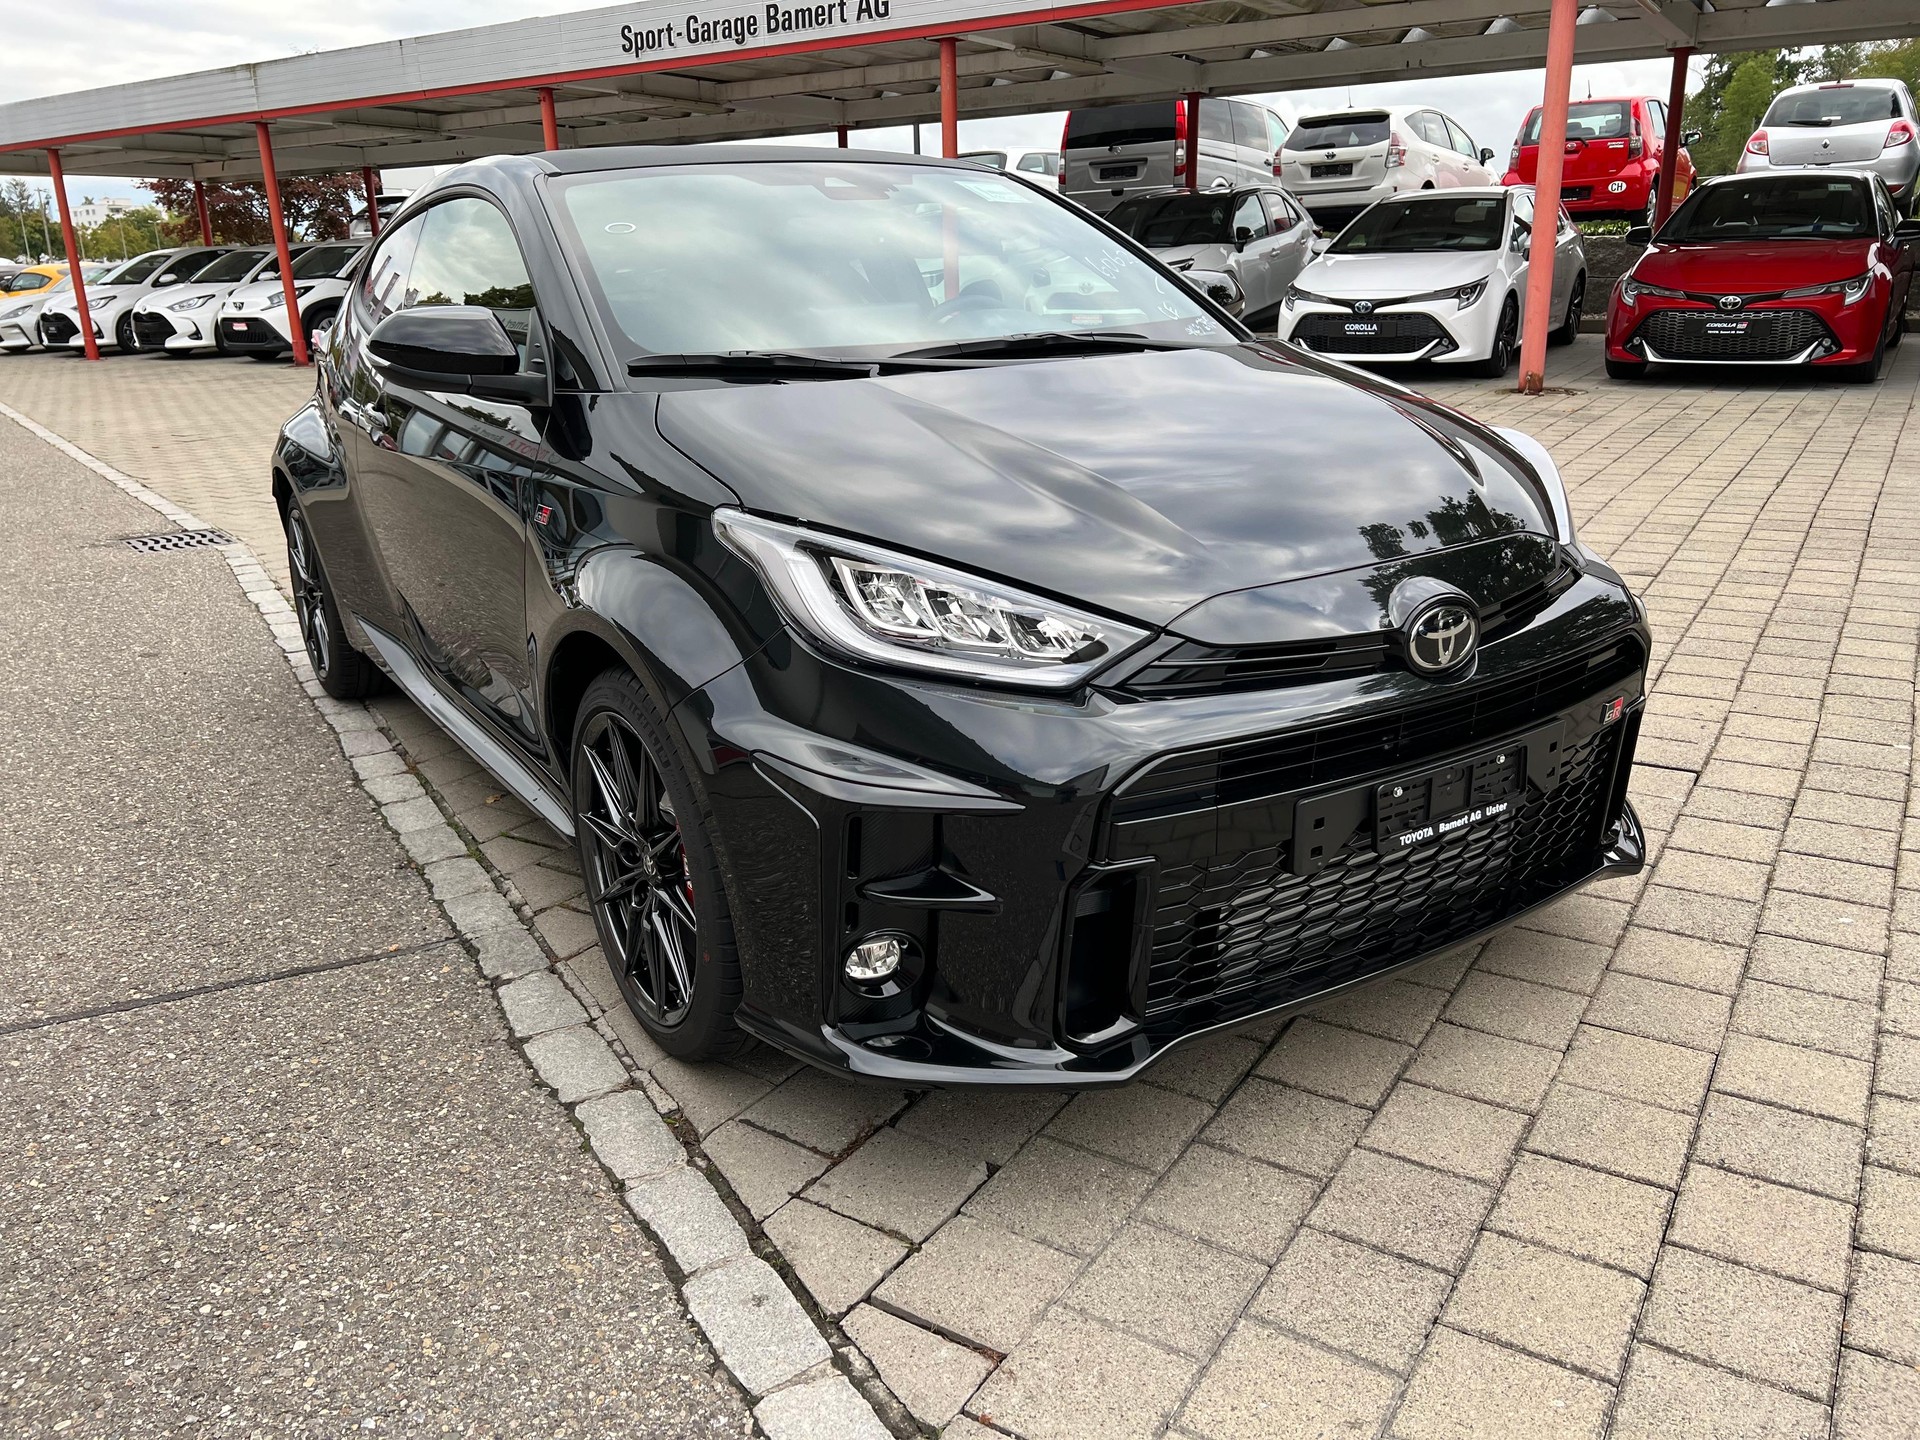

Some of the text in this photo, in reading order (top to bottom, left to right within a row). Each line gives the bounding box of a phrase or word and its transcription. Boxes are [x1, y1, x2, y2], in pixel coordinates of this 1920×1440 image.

[621, 0, 890, 58] Sport-Garage Bamert AG
[1610, 182, 1624, 192] CH
[1344, 323, 1378, 331] COROLLA
[1604, 704, 1621, 723] GR
[1400, 802, 1508, 846] TOYOTA Bamert AG Uster
